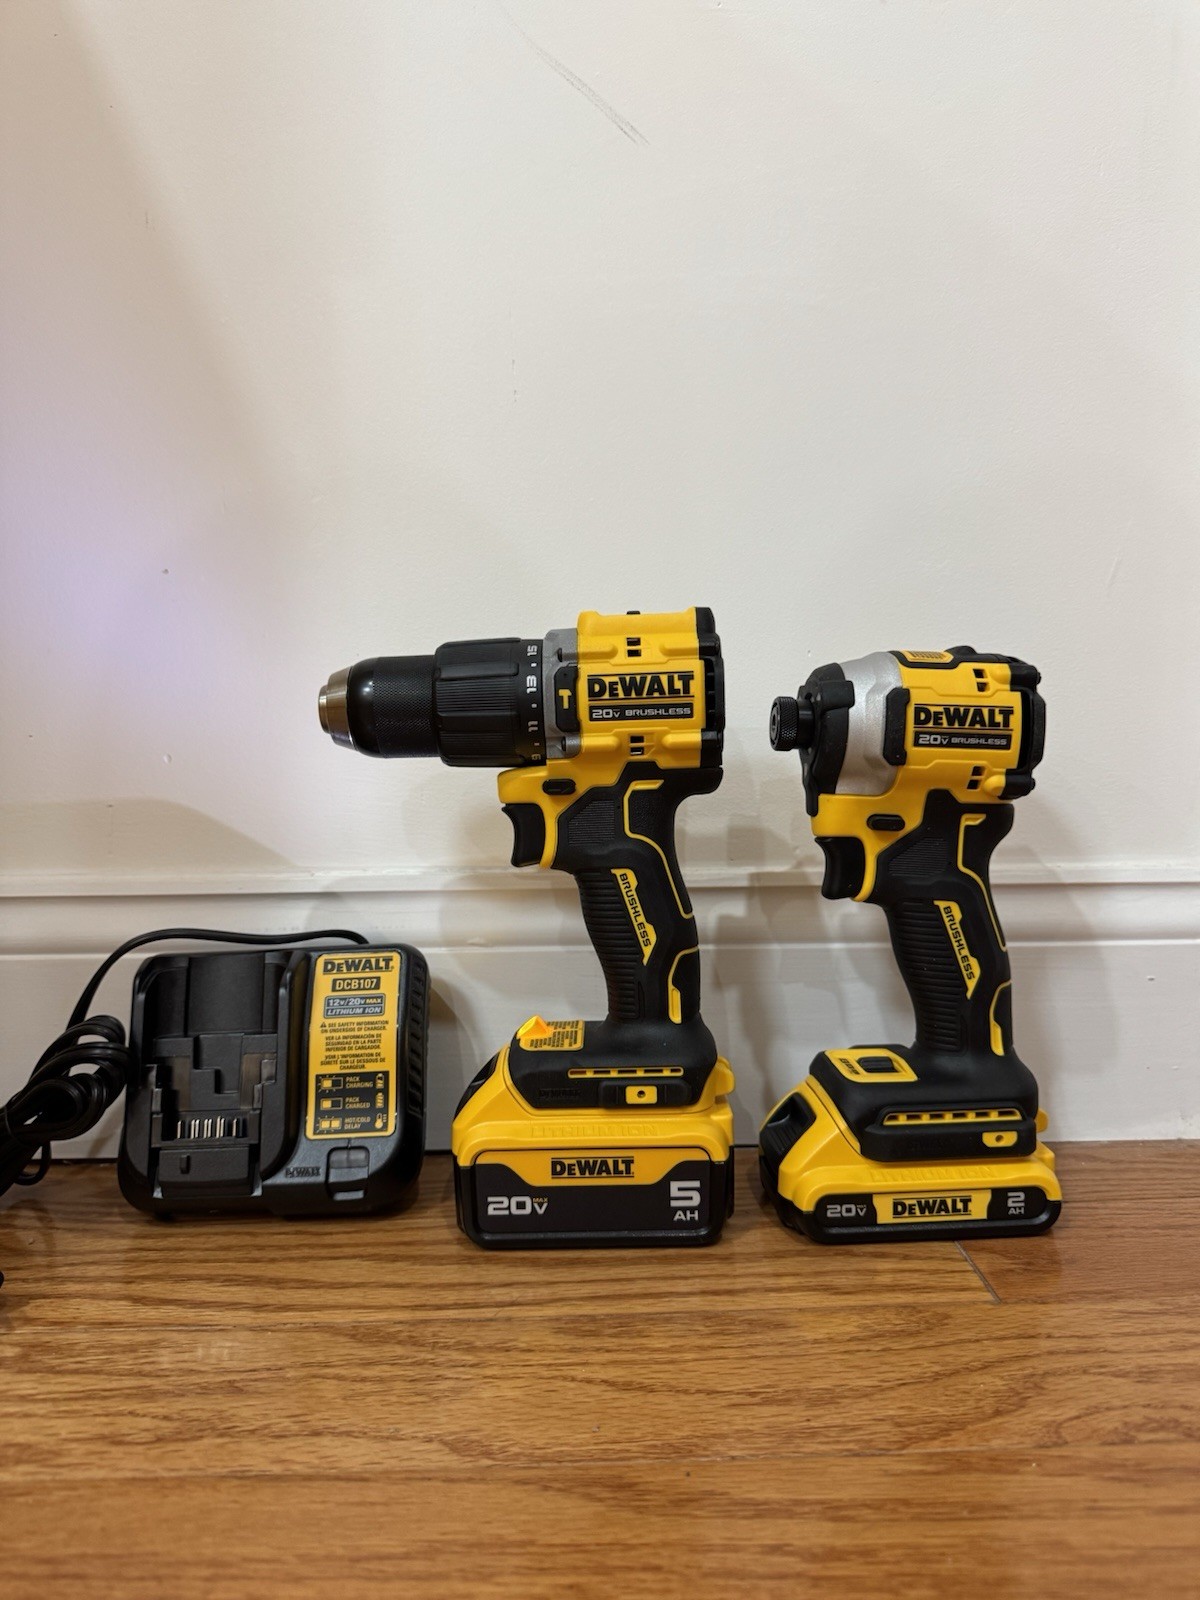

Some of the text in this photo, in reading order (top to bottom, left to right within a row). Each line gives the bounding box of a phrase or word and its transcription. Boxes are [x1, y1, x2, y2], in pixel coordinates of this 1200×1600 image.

[527, 645, 537, 656] 15
[526, 675, 537, 693] 13
[625, 707, 691, 717] BRUSHLESS
[528, 721, 538, 732] 11
[951, 737, 1007, 746] BRUSHLESS
[619, 873, 652, 947] BRUSHLESS
[943, 906, 975, 980] BRUSHLESS
[336, 979, 377, 990] DCB107
[670, 1180, 701, 1207] 5
[1007, 1191, 1025, 1207] 2
[673, 1210, 698, 1221] AH
[1008, 1207, 1024, 1216] AH
